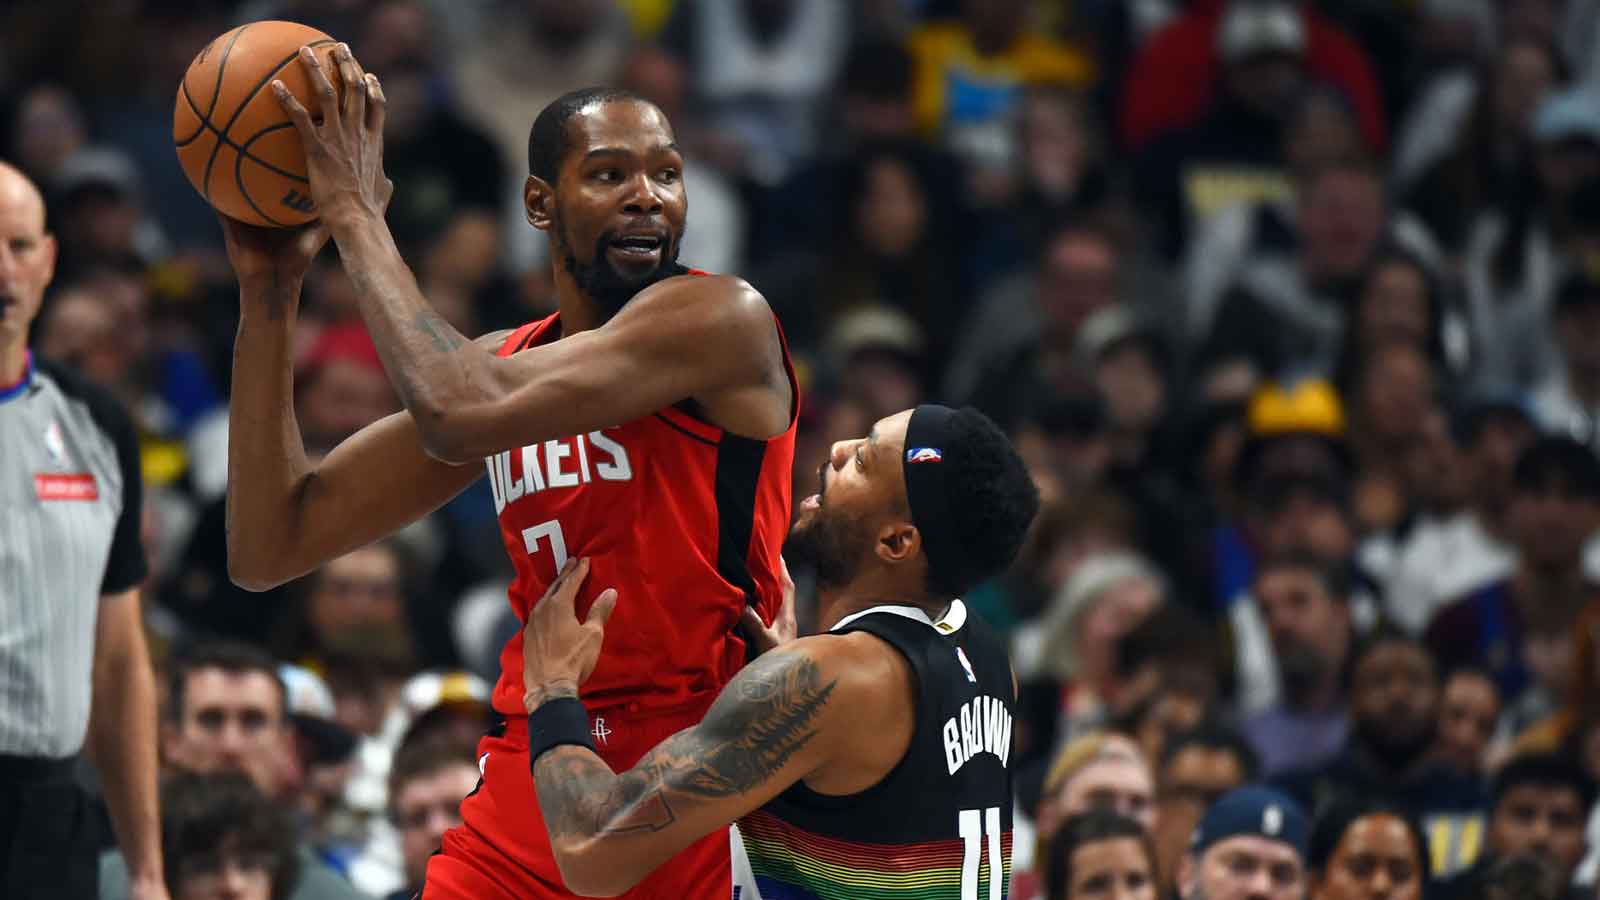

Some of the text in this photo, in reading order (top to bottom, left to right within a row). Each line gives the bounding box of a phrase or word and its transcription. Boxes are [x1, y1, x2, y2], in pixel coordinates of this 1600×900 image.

[521, 519, 567, 576] 7
[943, 695, 1012, 776] BROWN
[959, 807, 1003, 900] 11
